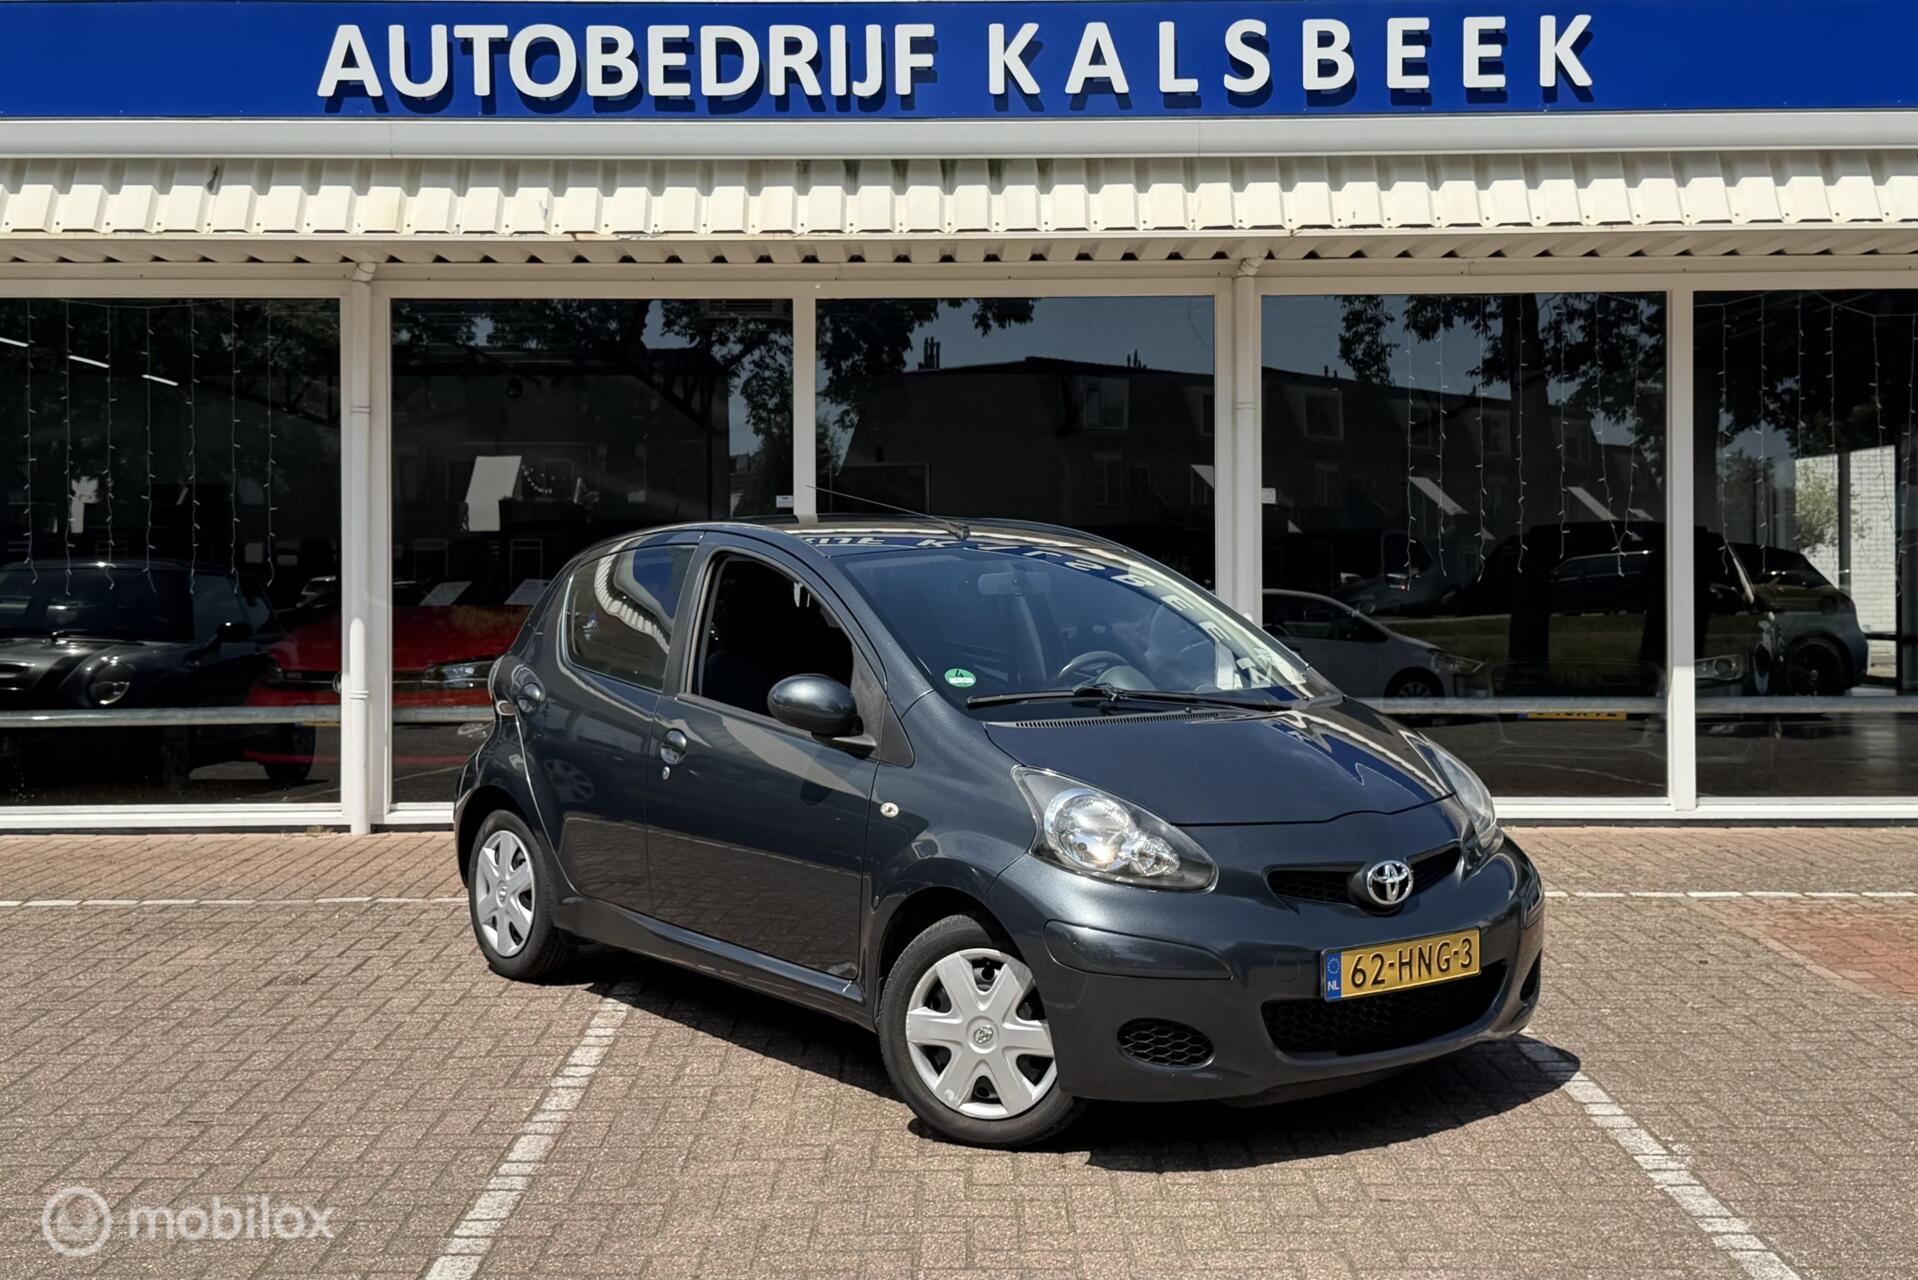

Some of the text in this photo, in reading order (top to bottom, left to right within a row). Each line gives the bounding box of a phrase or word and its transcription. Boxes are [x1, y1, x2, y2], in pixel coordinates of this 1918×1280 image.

[317, 14, 1594, 98] AUTOBEDRIJF KALSBEEK
[1327, 980, 1340, 991] NL
[1351, 938, 1473, 988] 62-HNG-3
